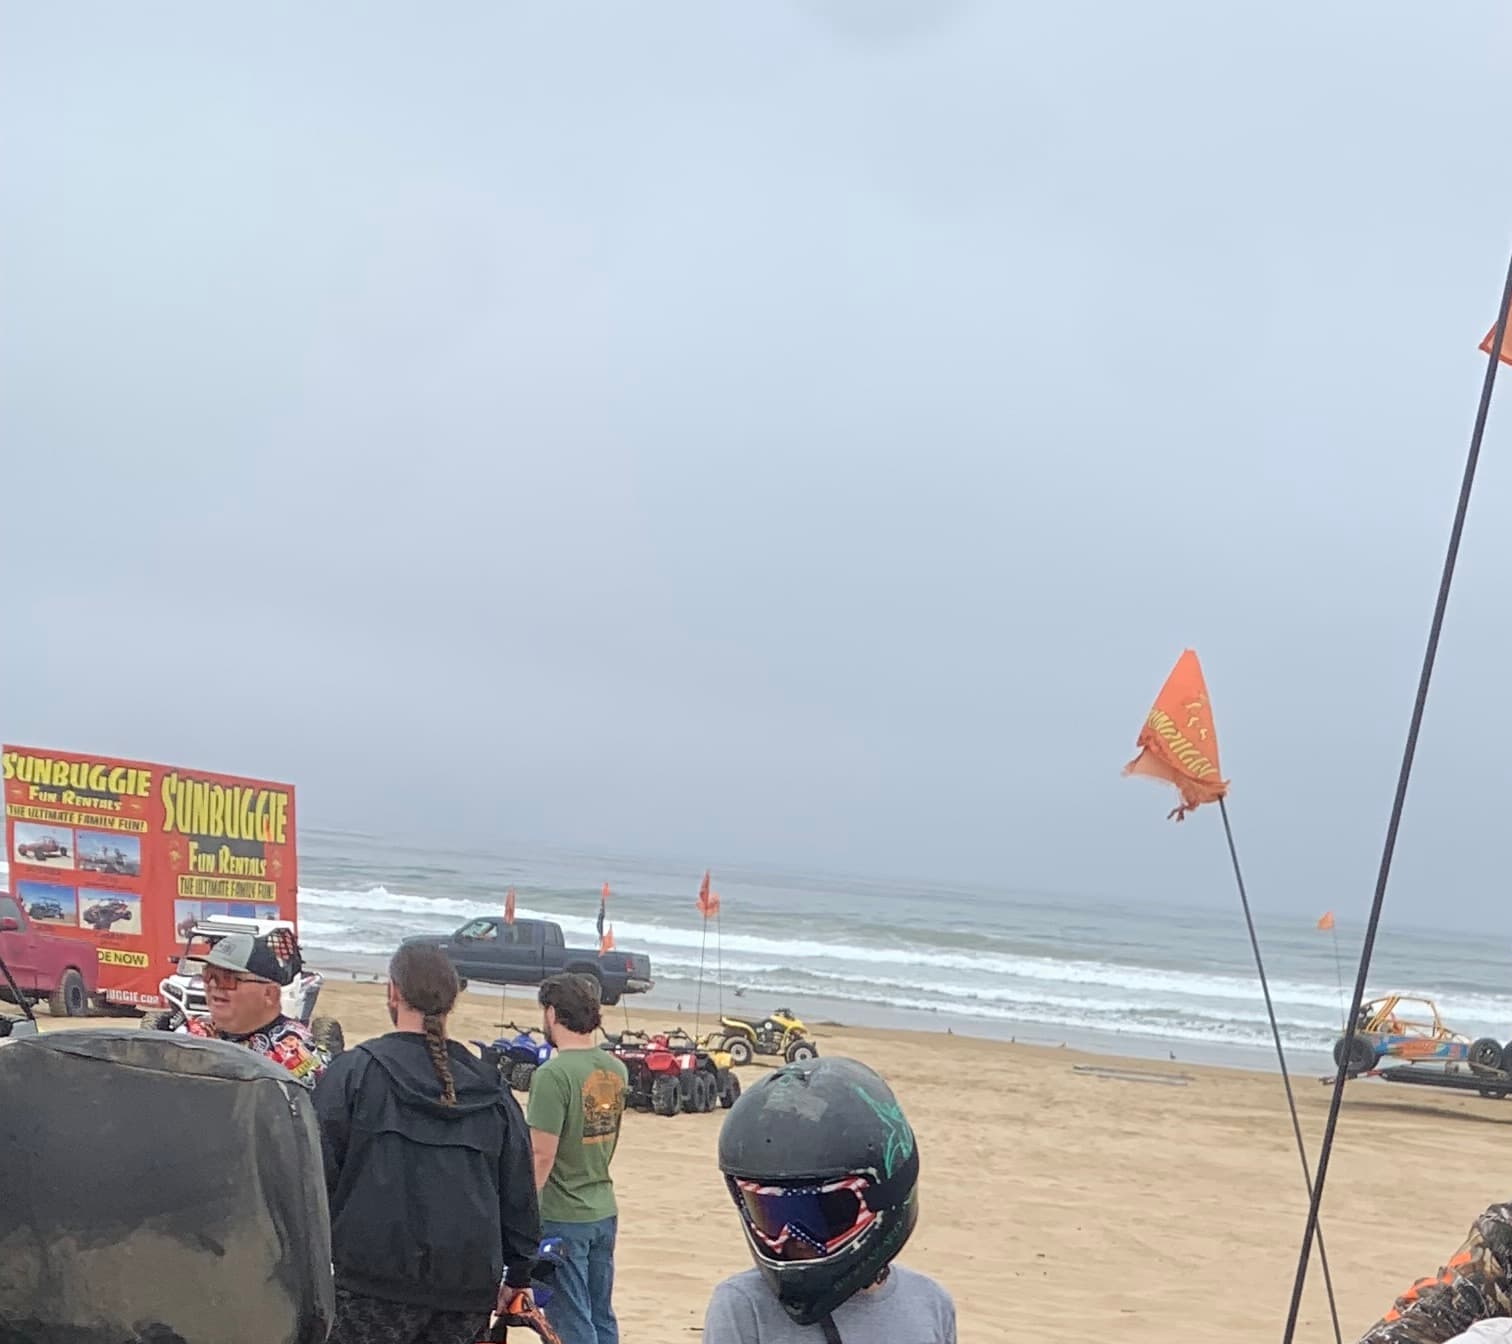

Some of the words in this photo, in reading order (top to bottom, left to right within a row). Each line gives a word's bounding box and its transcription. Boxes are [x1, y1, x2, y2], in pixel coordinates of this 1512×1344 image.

[2, 752, 152, 797] SUNBUGGIE
[9, 804, 25, 817] THE
[28, 806, 75, 824] ULTIMATE
[77, 812, 115, 829] FAMILY
[117, 818, 145, 832] FUN!
[162, 772, 288, 844] SUNBUGGIE
[113, 951, 145, 966] NOW
